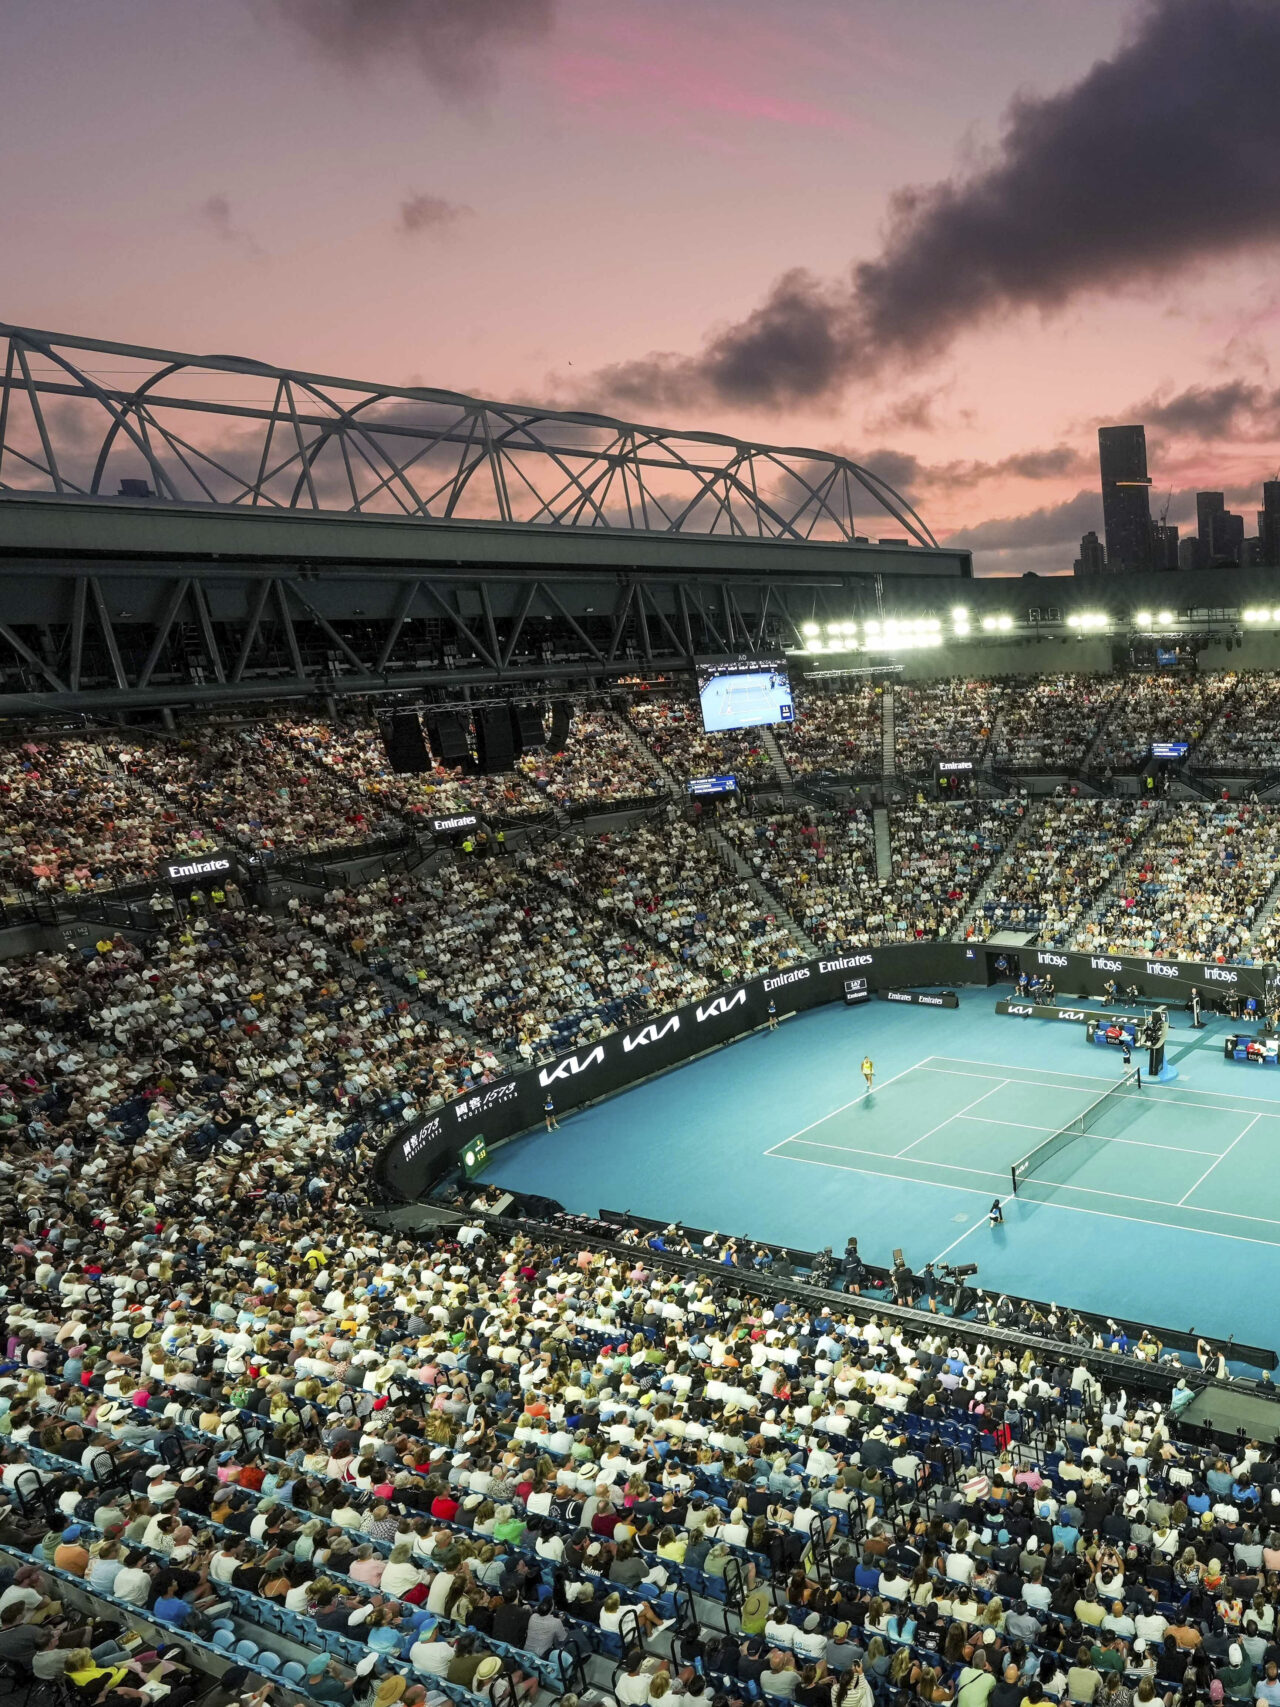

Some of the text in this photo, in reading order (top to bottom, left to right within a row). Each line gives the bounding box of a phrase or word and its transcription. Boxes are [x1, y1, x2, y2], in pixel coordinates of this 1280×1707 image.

[939, 762, 972, 770] Emirates
[434, 816, 476, 830] Emirates
[168, 859, 230, 878] Emirates
[763, 954, 873, 992] Emirates Emirates
[1038, 952, 1068, 967] Infosys
[1091, 957, 1122, 972] Infosys
[1146, 962, 1178, 978] Infosys
[1204, 967, 1238, 982] Infosys
[888, 992, 943, 1004] Emirates Emirates
